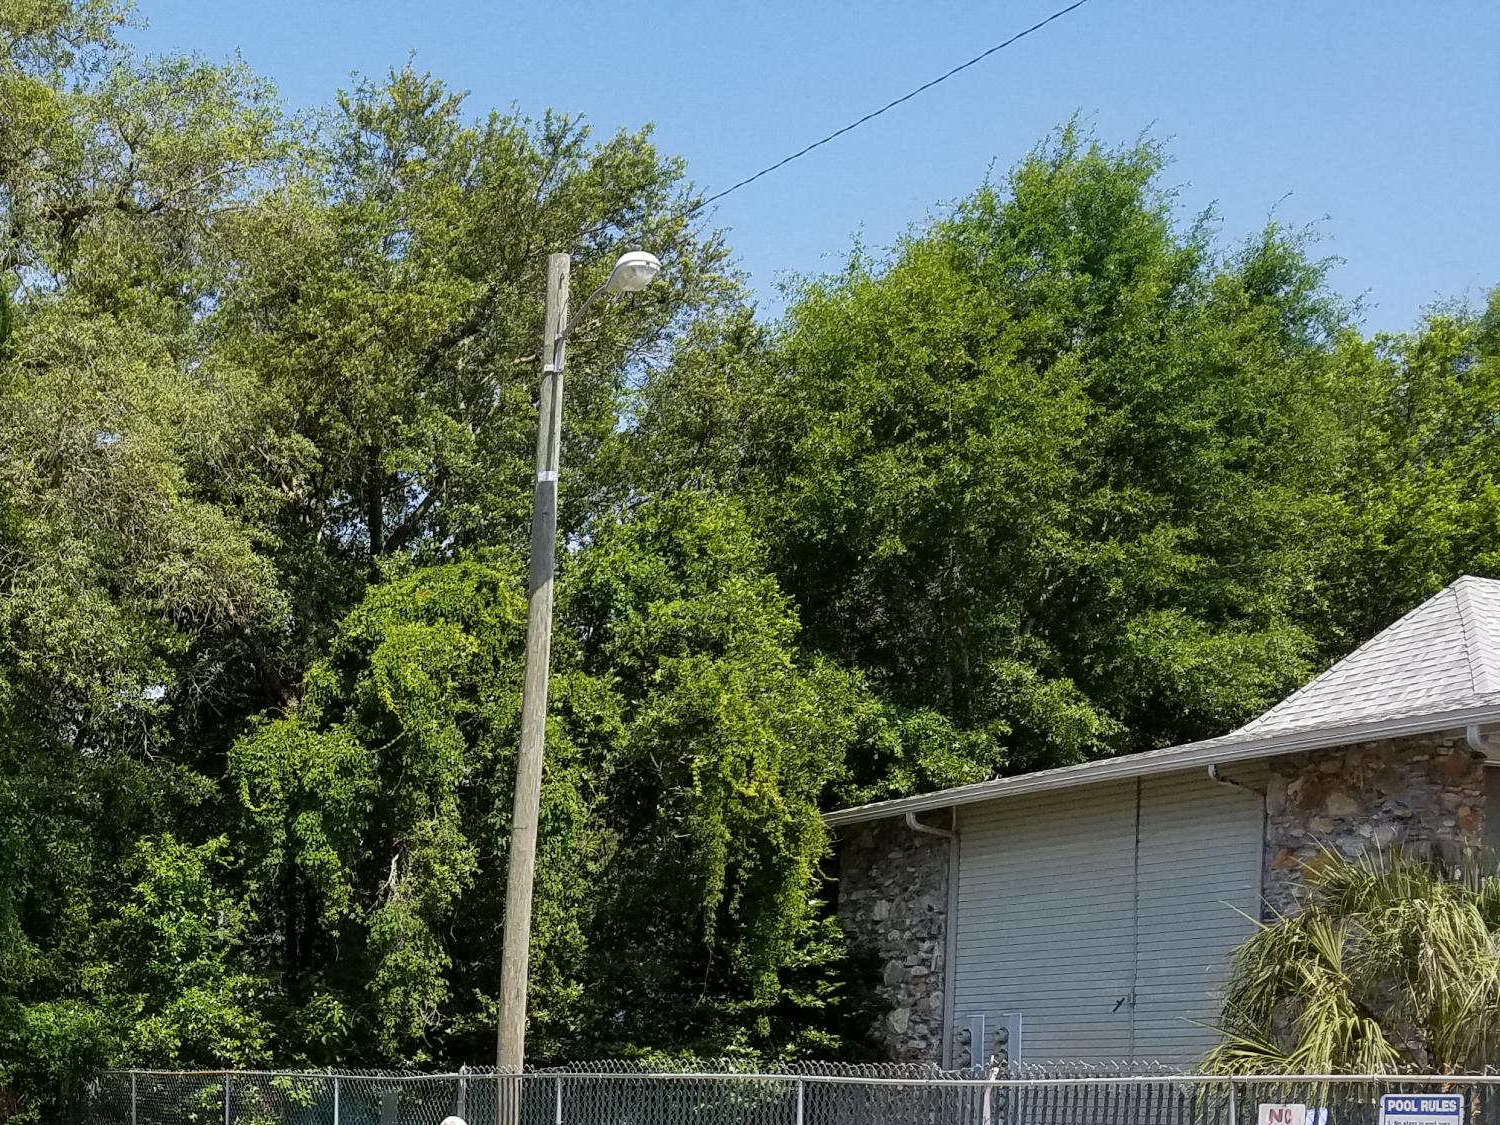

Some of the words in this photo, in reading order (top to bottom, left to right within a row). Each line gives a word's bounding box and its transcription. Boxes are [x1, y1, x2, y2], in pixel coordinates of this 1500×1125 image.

[1387, 1100, 1418, 1112] POOL
[1420, 1100, 1457, 1112] RULES
[1268, 1109, 1292, 1124] NO
